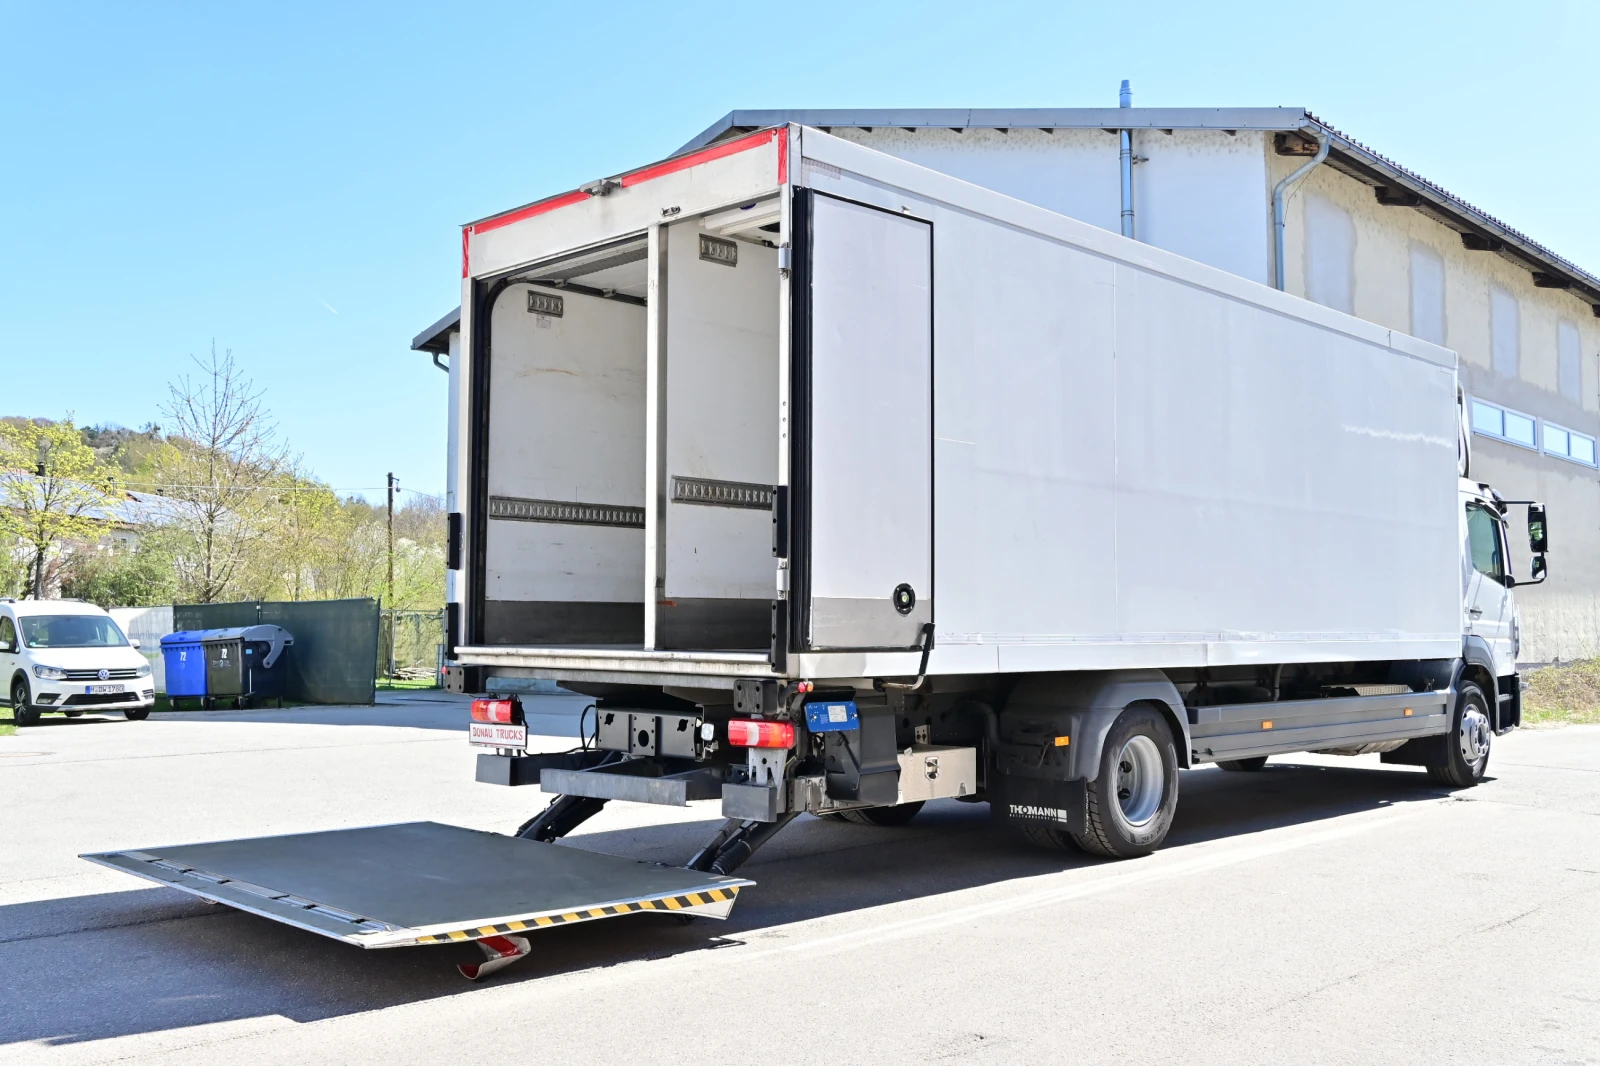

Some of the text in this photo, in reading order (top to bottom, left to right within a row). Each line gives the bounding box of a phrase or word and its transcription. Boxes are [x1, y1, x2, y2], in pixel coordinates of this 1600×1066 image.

[180, 651, 187, 661] 72
[221, 648, 227, 658] 72
[472, 727, 523, 740] DONAU TRUCKS
[1009, 804, 1057, 817] THOMANN
